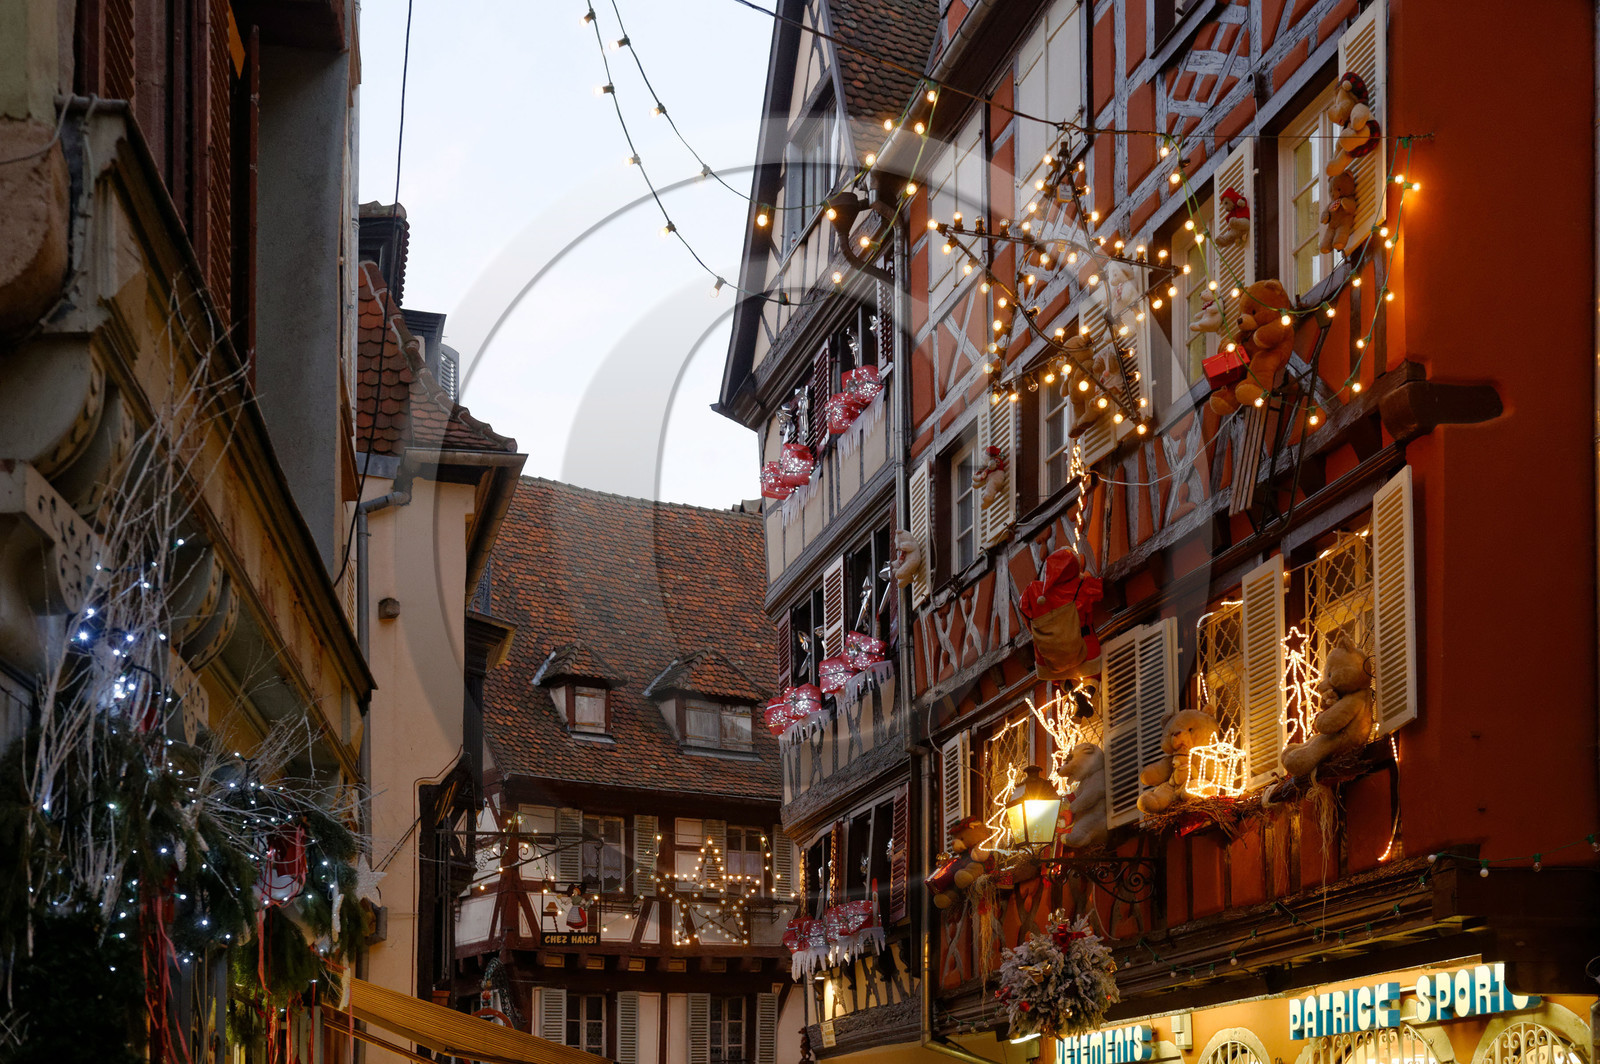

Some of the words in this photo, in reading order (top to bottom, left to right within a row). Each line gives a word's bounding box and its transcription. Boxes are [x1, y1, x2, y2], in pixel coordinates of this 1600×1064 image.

[544, 935, 568, 945] CHEZ
[571, 935, 597, 945] HANSI
[1289, 982, 1392, 1040] PATRICK
